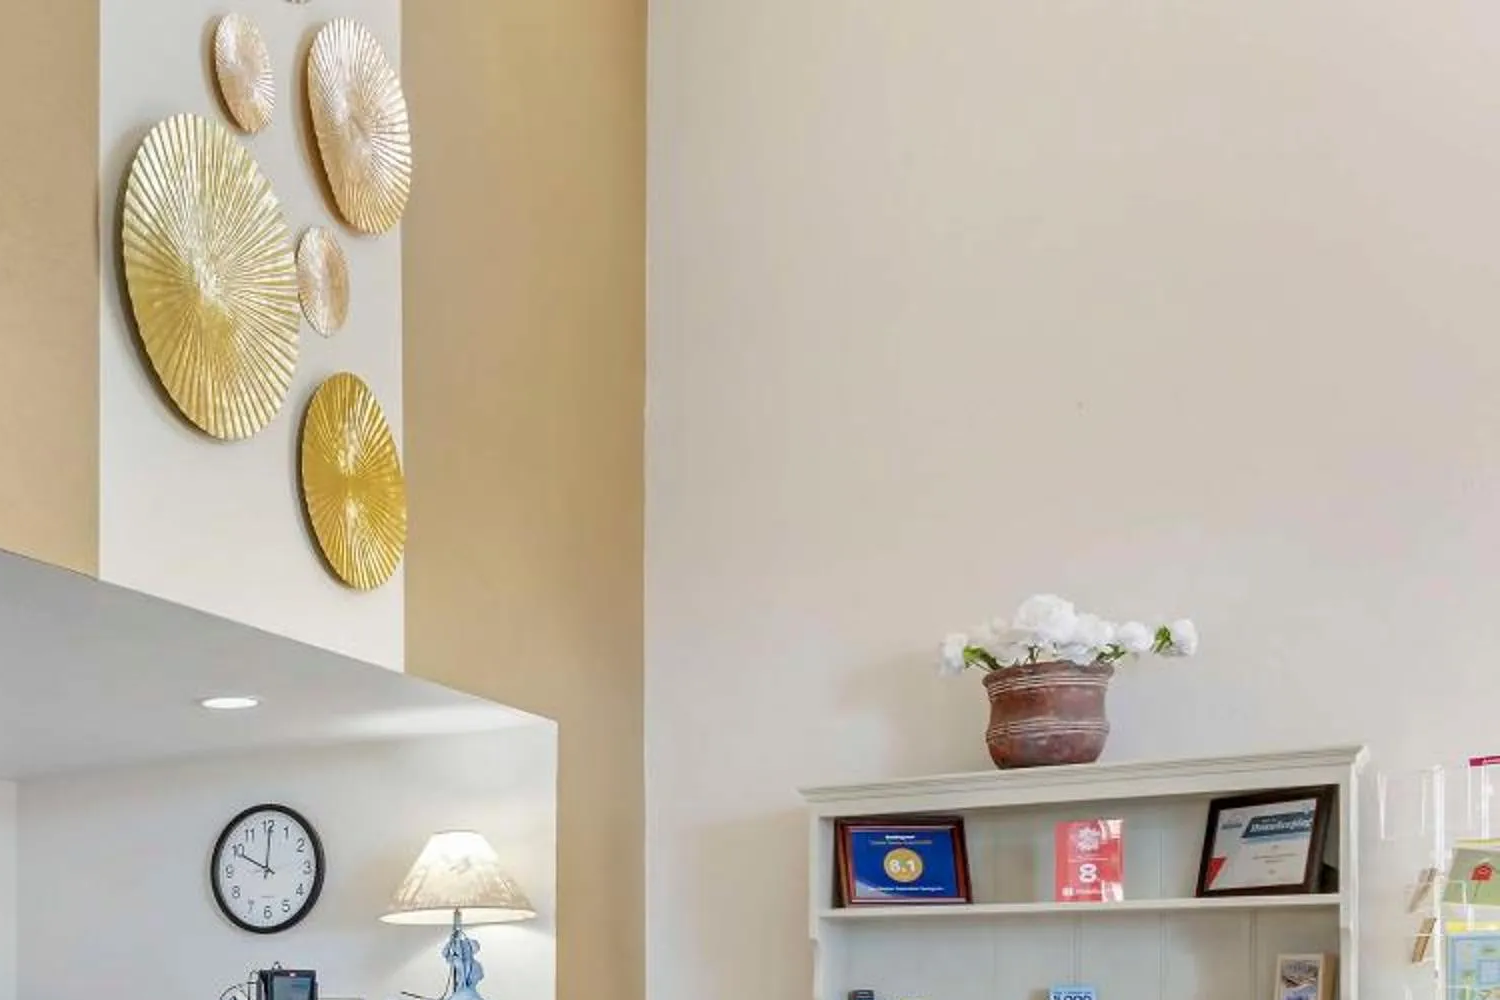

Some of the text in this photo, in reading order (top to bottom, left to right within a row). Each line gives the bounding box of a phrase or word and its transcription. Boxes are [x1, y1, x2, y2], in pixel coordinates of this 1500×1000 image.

[262, 820, 275, 833] 12
[283, 826, 289, 839] 1
[245, 828, 255, 842] 11
[231, 843, 245, 858] 10
[296, 838, 305, 853] 2
[225, 864, 234, 879] 9
[302, 860, 312, 875] 3
[231, 885, 241, 899] 8
[295, 883, 304, 896] 4
[263, 905, 273, 919] 6
[281, 899, 290, 913] 5
